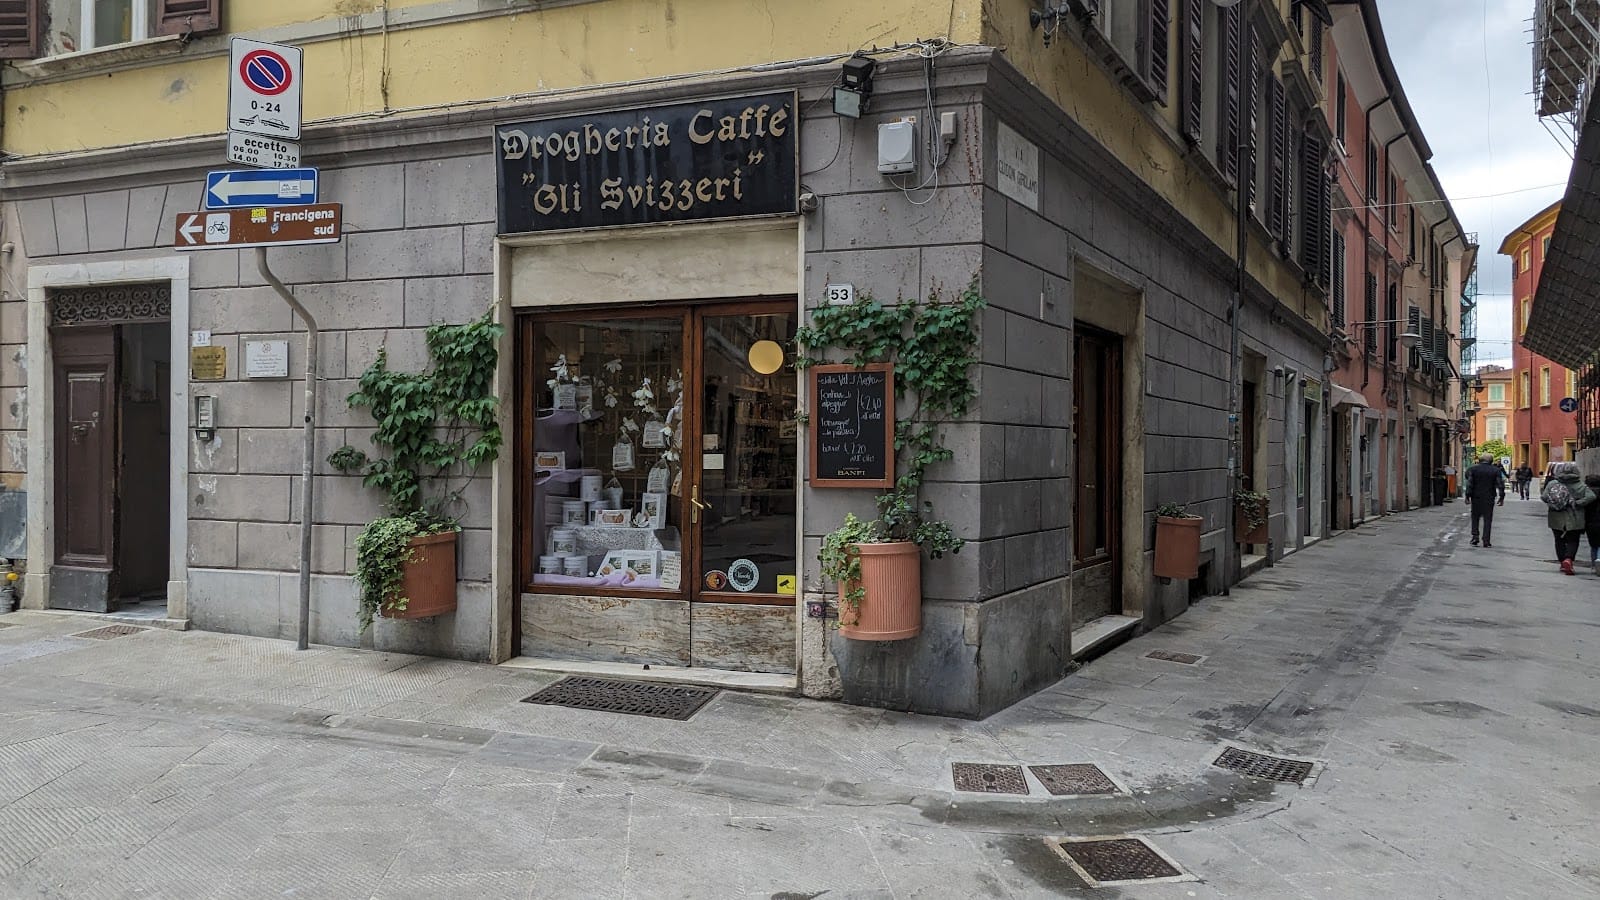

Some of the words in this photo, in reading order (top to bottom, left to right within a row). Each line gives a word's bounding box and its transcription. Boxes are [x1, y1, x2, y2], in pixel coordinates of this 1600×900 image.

[499, 115, 671, 161] Drogheria
[687, 103, 791, 145] Caffè
[244, 138, 287, 153] eccetto
[233, 145, 259, 155] 06.00
[274, 152, 297, 162] 10.30
[233, 153, 258, 163] 14.00
[273, 210, 335, 222] Francigena
[313, 224, 335, 235] sud
[831, 289, 849, 300] 53
[197, 332, 206, 342] 51
